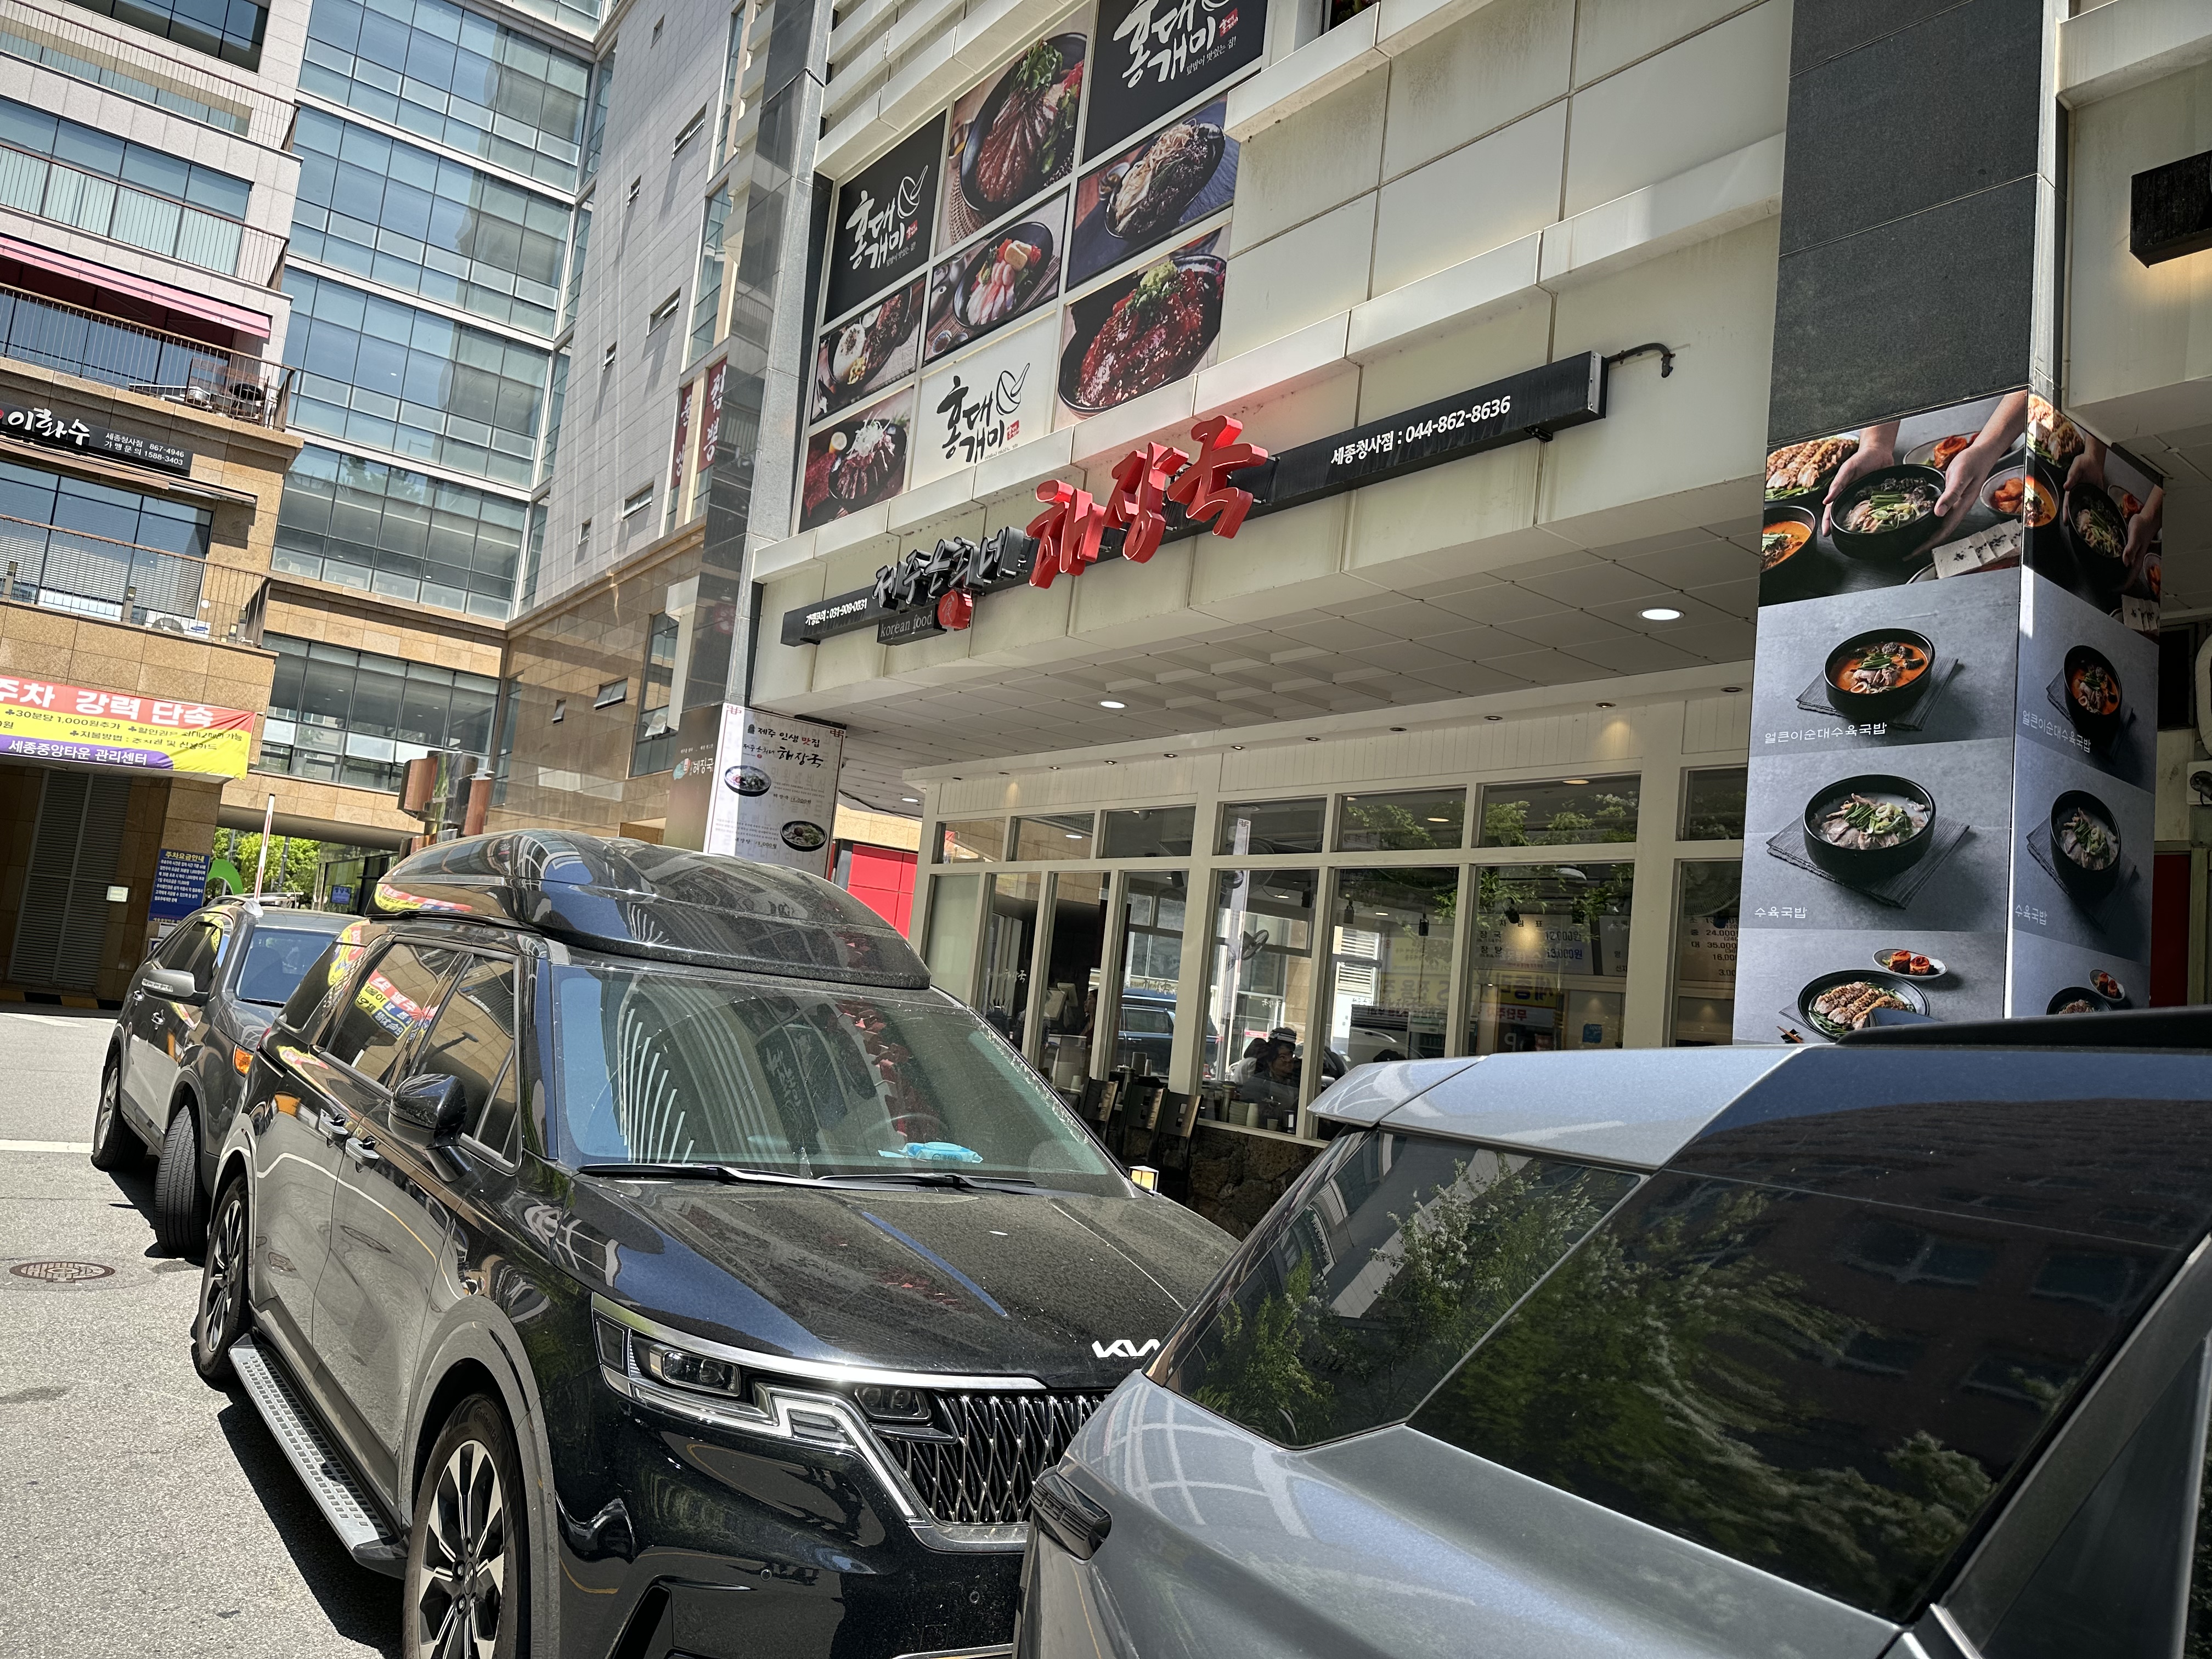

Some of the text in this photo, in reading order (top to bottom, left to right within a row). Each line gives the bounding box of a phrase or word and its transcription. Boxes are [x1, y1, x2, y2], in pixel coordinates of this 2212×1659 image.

[7, 408, 91, 446] 이화수
[1330, 430, 1395, 465] 세종청사점
[1404, 395, 1511, 444] 044-862-8636
[105, 432, 185, 458] 세종청사점 867-4946
[144, 450, 183, 466] 1588-3403
[880, 610, 933, 638] korean food
[76, 690, 141, 720] 강력
[151, 701, 214, 727] 단속
[758, 727, 820, 748] 제주 인생 맛집
[1765, 722, 1887, 744] 얼큰이순대수육국밥
[2022, 710, 2091, 753] 얼큰이순대수육국밥
[8, 740, 147, 766] 세종중앙타운 관리센터
[777, 746, 824, 769] 해장국
[1754, 906, 1808, 918] 수육국밥
[2015, 905, 2047, 926] 수육국밥
